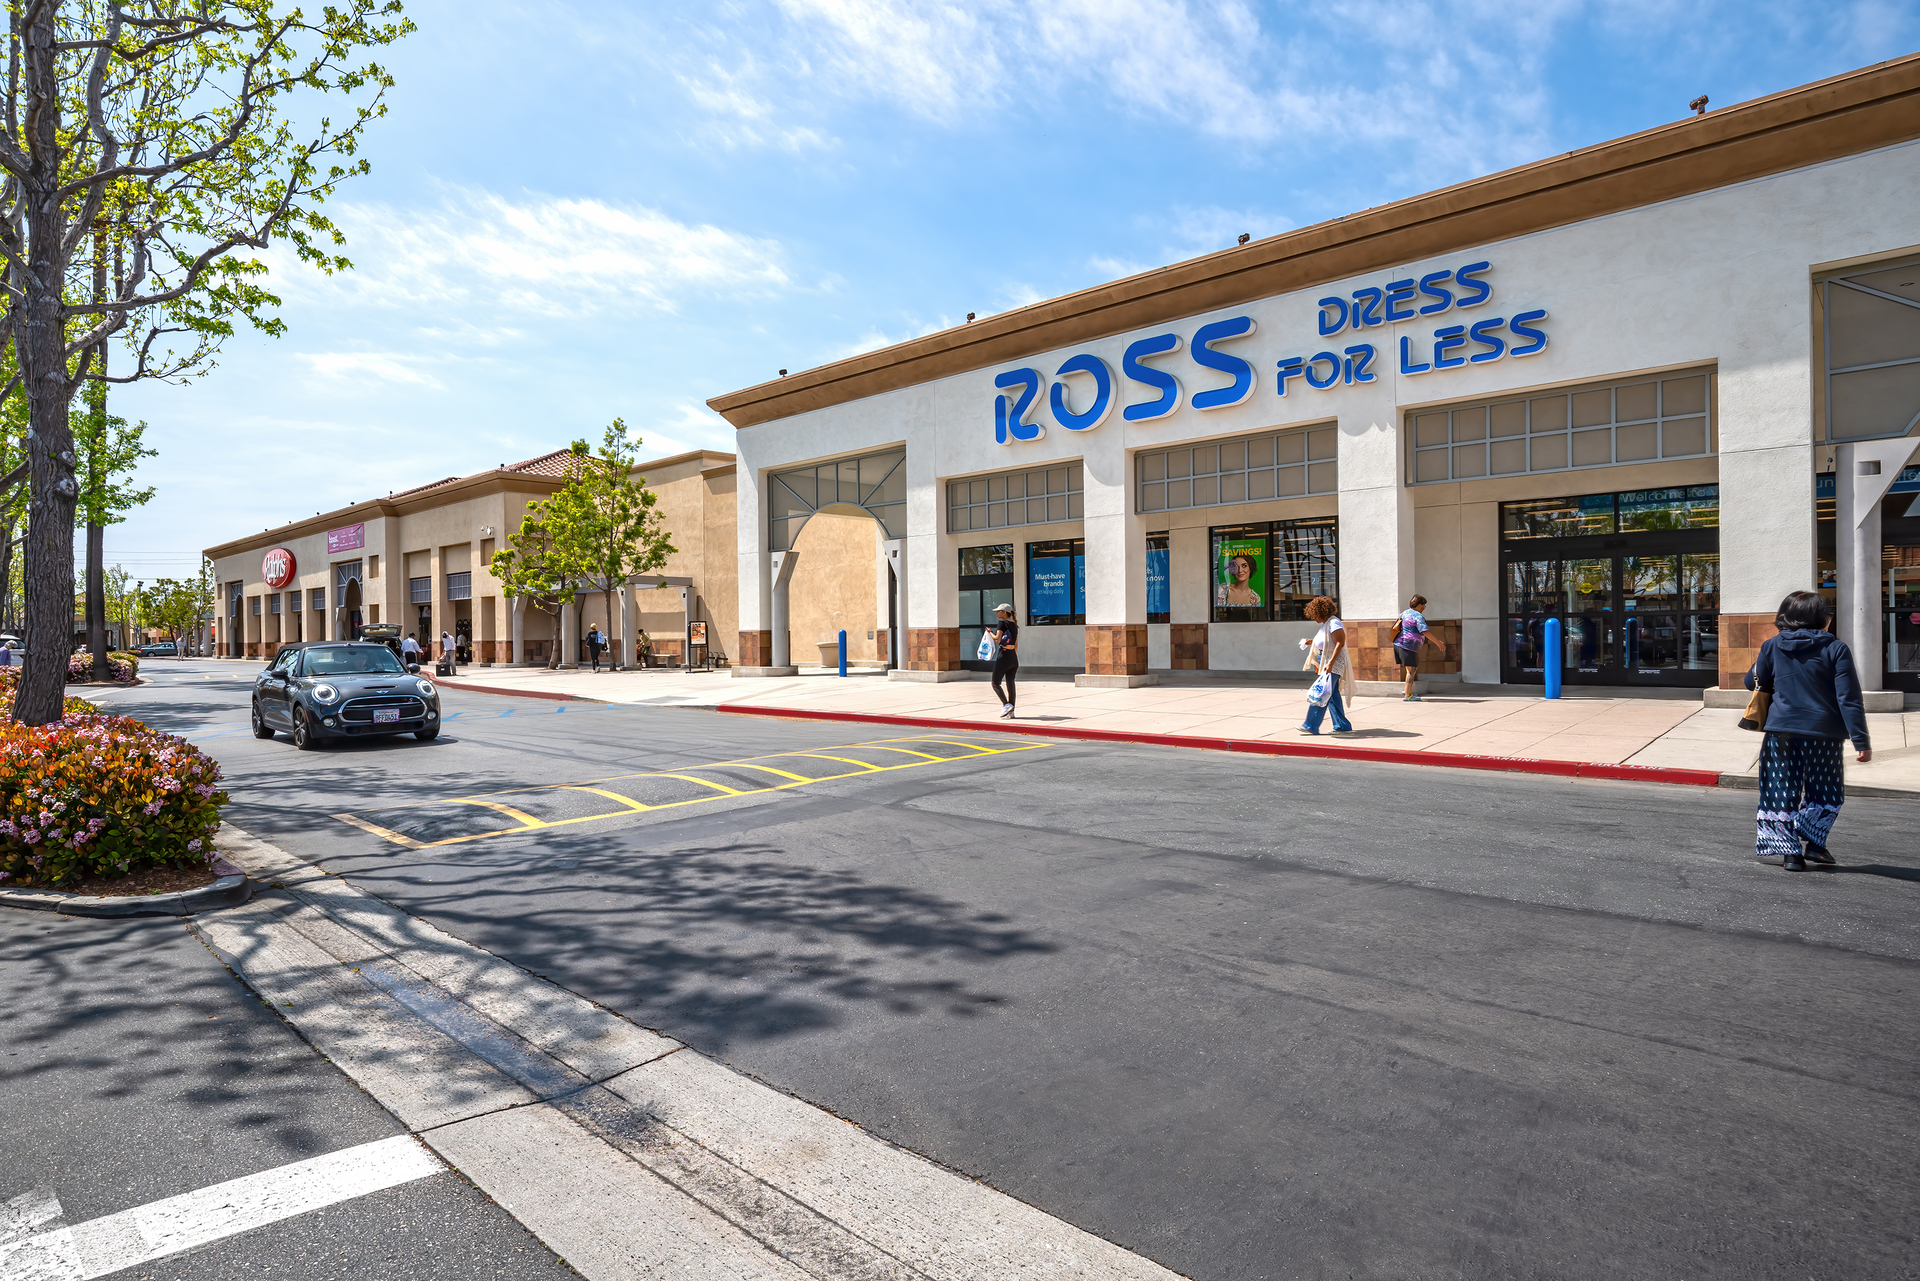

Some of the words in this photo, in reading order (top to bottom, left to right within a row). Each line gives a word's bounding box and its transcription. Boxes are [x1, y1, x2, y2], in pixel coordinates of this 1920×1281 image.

[1318, 260, 1493, 337] DRESS
[1276, 343, 1378, 398] FOR
[1400, 309, 1549, 376] LESS
[994, 316, 1257, 446] ROSS
[1621, 490, 1686, 503] Welcome
[1691, 488, 1706, 498] to
[264, 553, 286, 584] Ralphs
[1222, 547, 1262, 556] SAVINGS!
